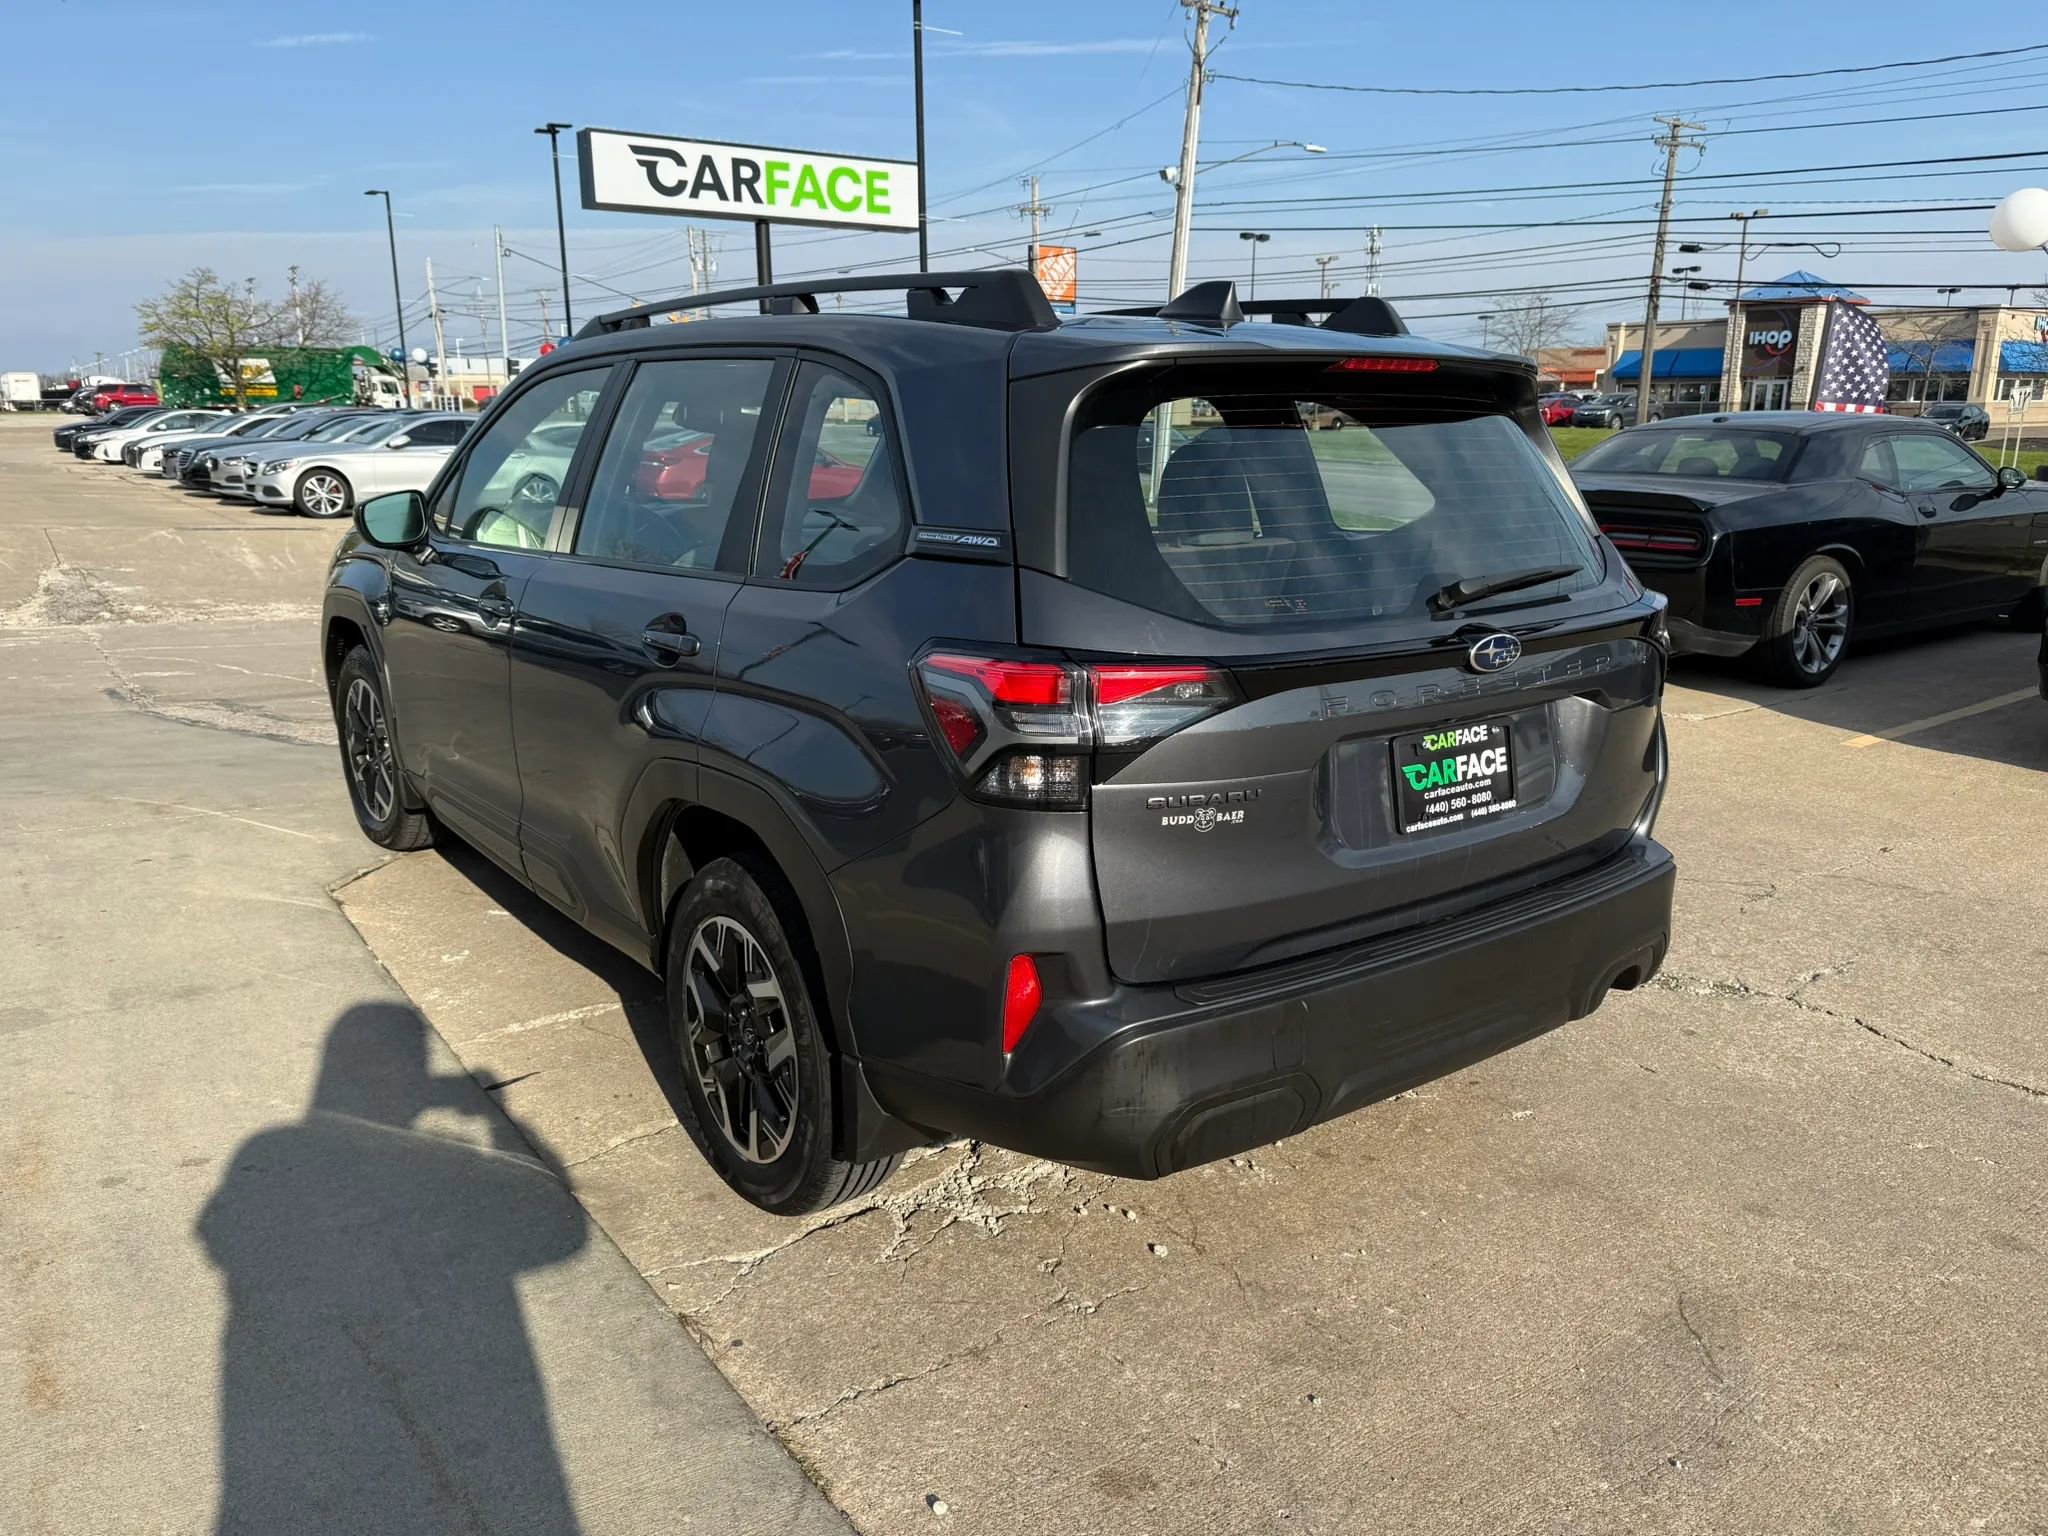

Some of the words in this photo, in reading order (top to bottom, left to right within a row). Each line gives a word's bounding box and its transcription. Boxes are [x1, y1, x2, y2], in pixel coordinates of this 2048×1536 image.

[628, 144, 891, 214] CARFACE
[1748, 329, 1792, 349] IHOP
[957, 535, 998, 546] AWD
[1320, 656, 1611, 720] FORESTER
[1423, 724, 1488, 751] CARFACE
[1402, 747, 1508, 791] CARFACE
[1145, 788, 1262, 810] SUBARU
[1424, 779, 1491, 799] carfaceauto.com
[1161, 815, 1195, 826] BUDD
[1216, 810, 1245, 822] BAER
[1426, 800, 1449, 815] (440)
[1406, 813, 1463, 833] carfaceauto.com
[1470, 806, 1488, 819] (440)
